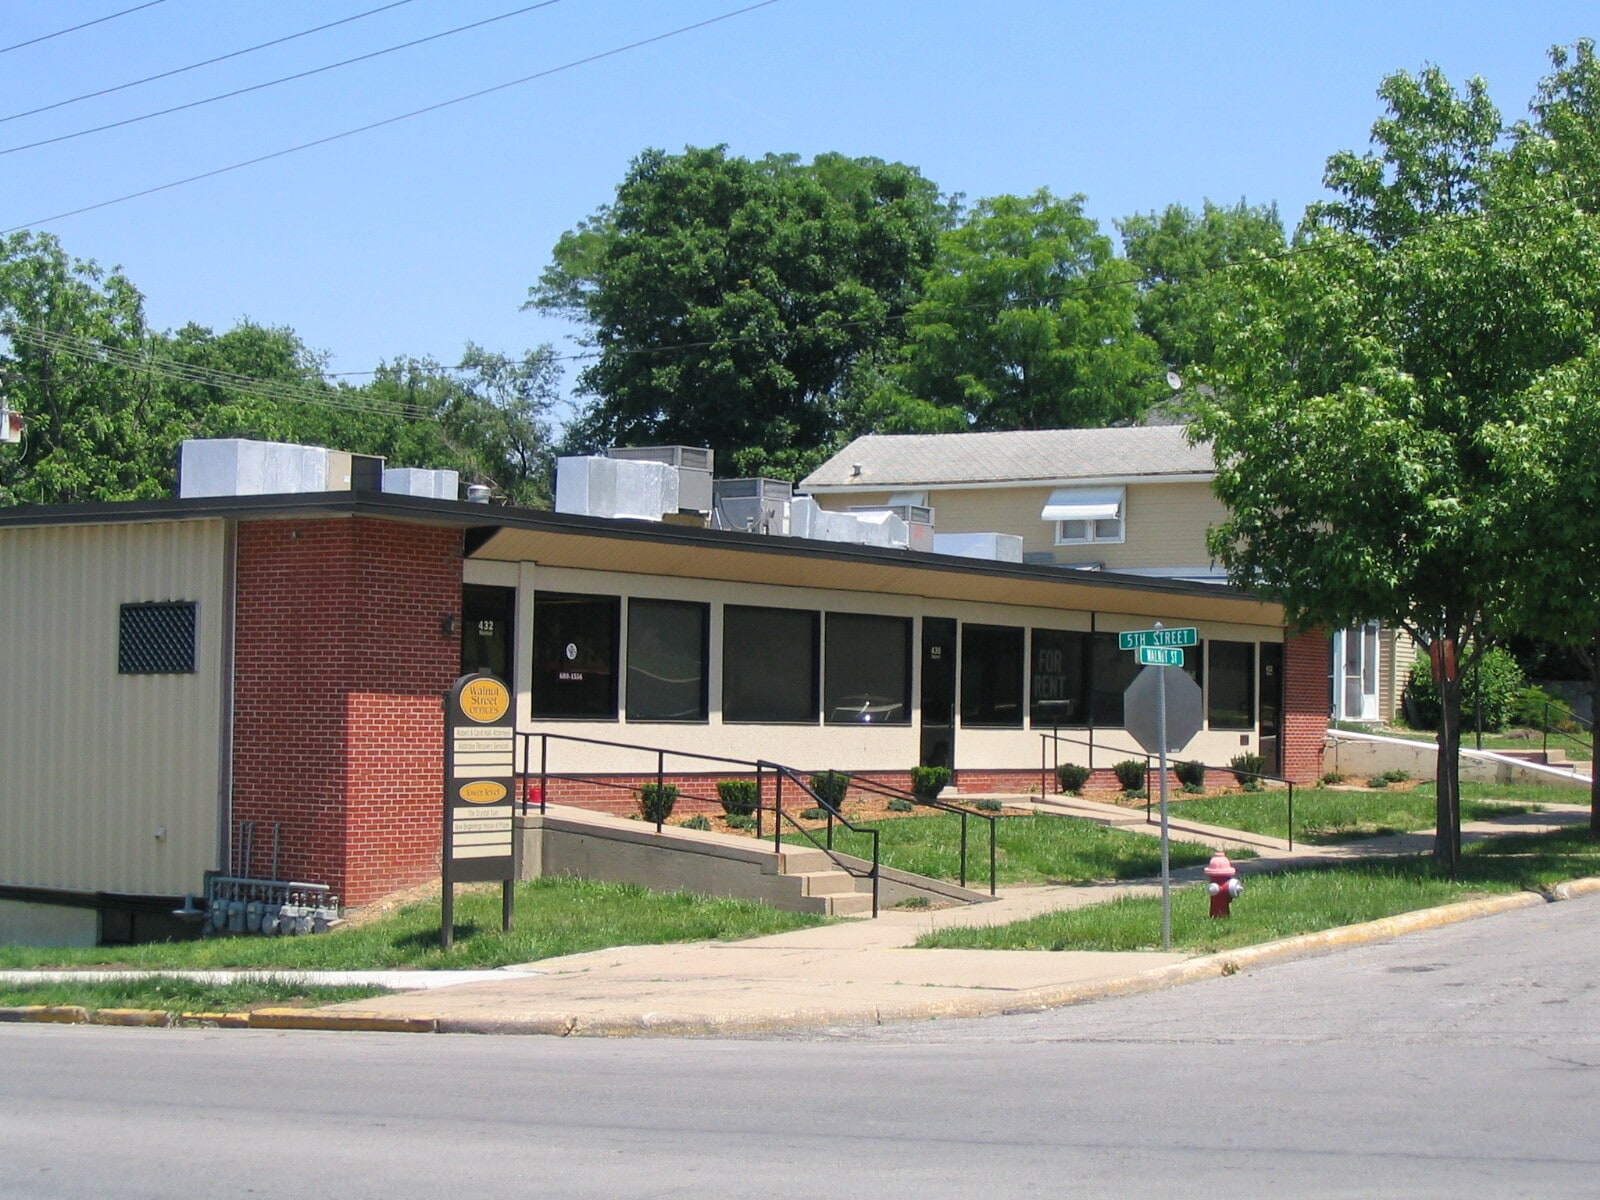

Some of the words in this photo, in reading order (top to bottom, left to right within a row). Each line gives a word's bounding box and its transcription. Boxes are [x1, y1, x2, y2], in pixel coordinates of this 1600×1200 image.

[478, 620, 494, 630] 432
[1127, 633, 1146, 647] 5TH
[1153, 630, 1188, 646] STREET
[1038, 649, 1062, 672] FOR
[470, 686, 499, 696] Walnut
[1034, 674, 1066, 699] RENT
[471, 695, 498, 706] Street
